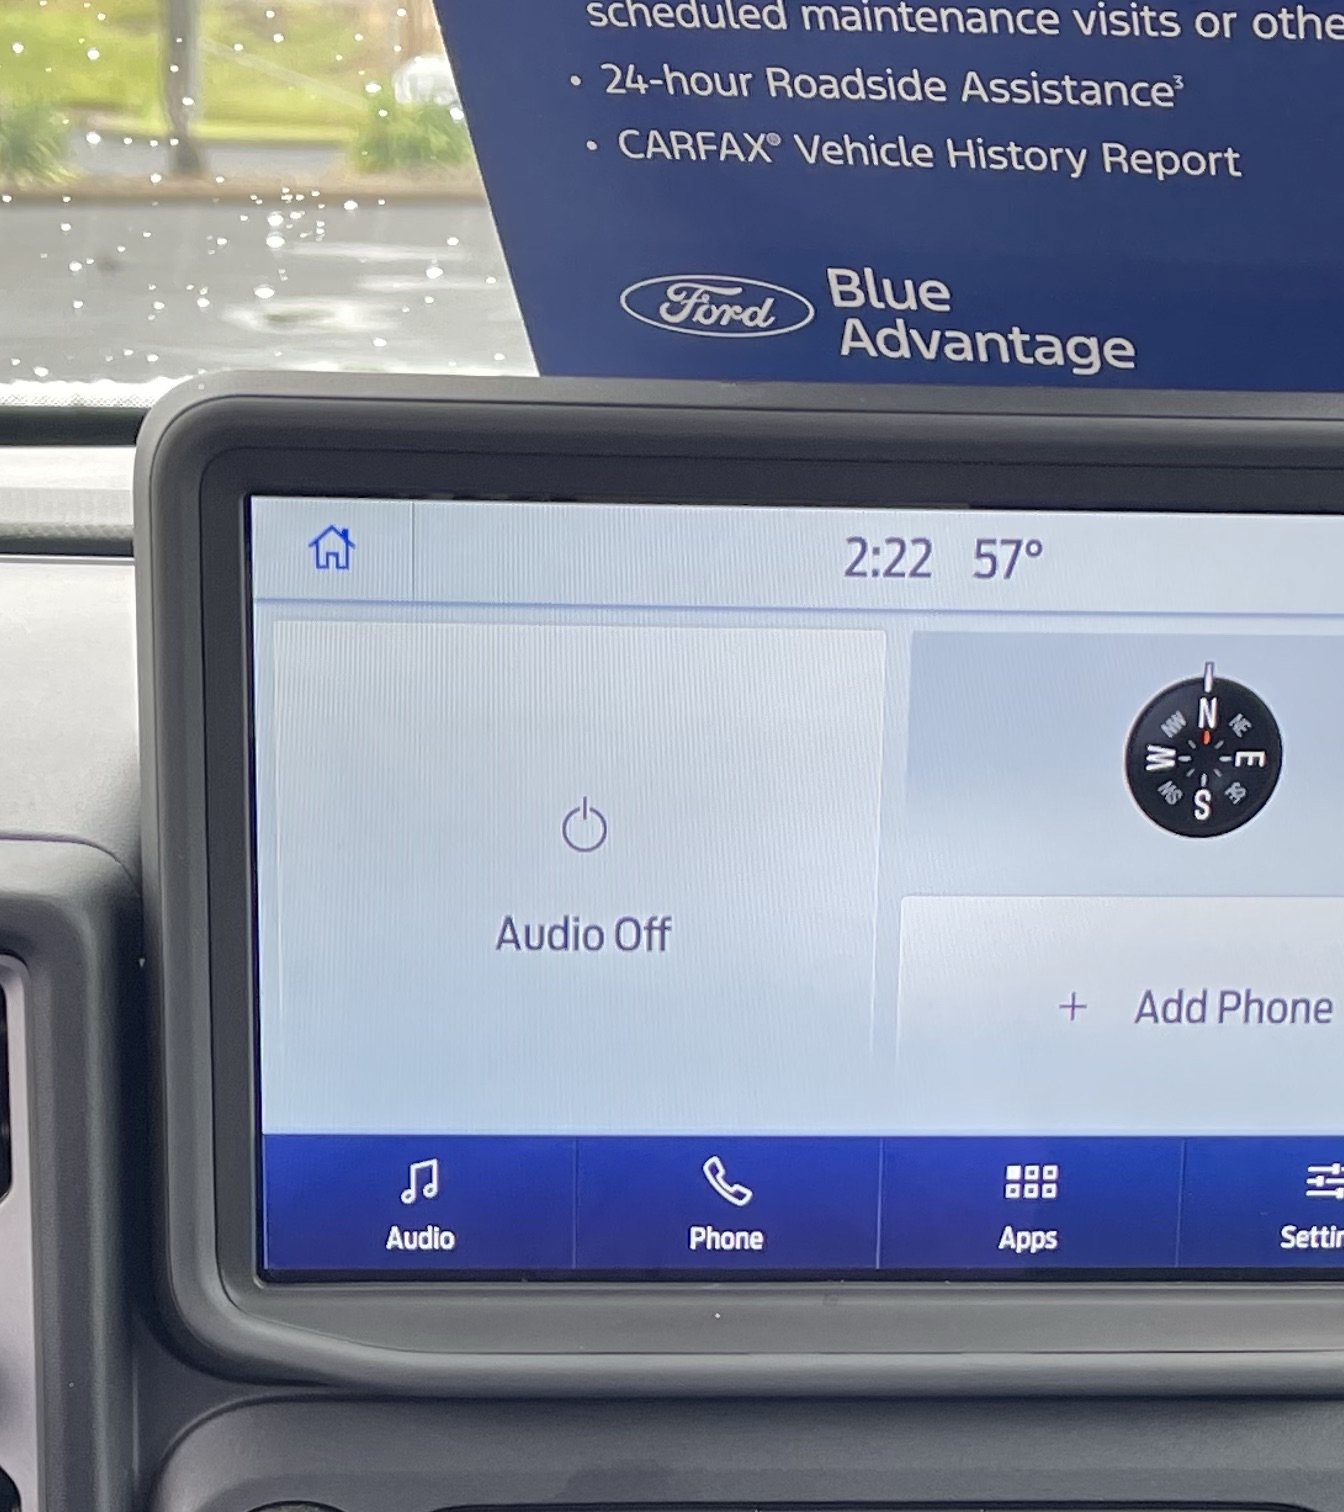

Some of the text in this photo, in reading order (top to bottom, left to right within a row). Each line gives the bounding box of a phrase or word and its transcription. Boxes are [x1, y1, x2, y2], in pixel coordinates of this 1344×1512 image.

[586, 0, 788, 31] scheduled
[800, 0, 1060, 35] maintenance
[1072, 1, 1182, 38] visits
[1194, 9, 1237, 39] or
[600, 63, 752, 98] 24-hour
[765, 67, 947, 101] Roadside
[793, 135, 934, 168] Vehicle
[946, 138, 1087, 179] History
[1102, 142, 1242, 181] Report
[659, 281, 776, 329] Ford
[827, 266, 951, 312] Blue
[840, 317, 1136, 375] Advantage
[844, 536, 933, 578] 2:22
[1198, 697, 1217, 729] N
[1194, 788, 1212, 821] S
[495, 914, 673, 952] Audio Off
[1134, 987, 1334, 1024] Add Phone
[385, 1225, 456, 1251] Audio
[689, 1226, 764, 1250] Phone
[998, 1225, 1058, 1254] Apps
